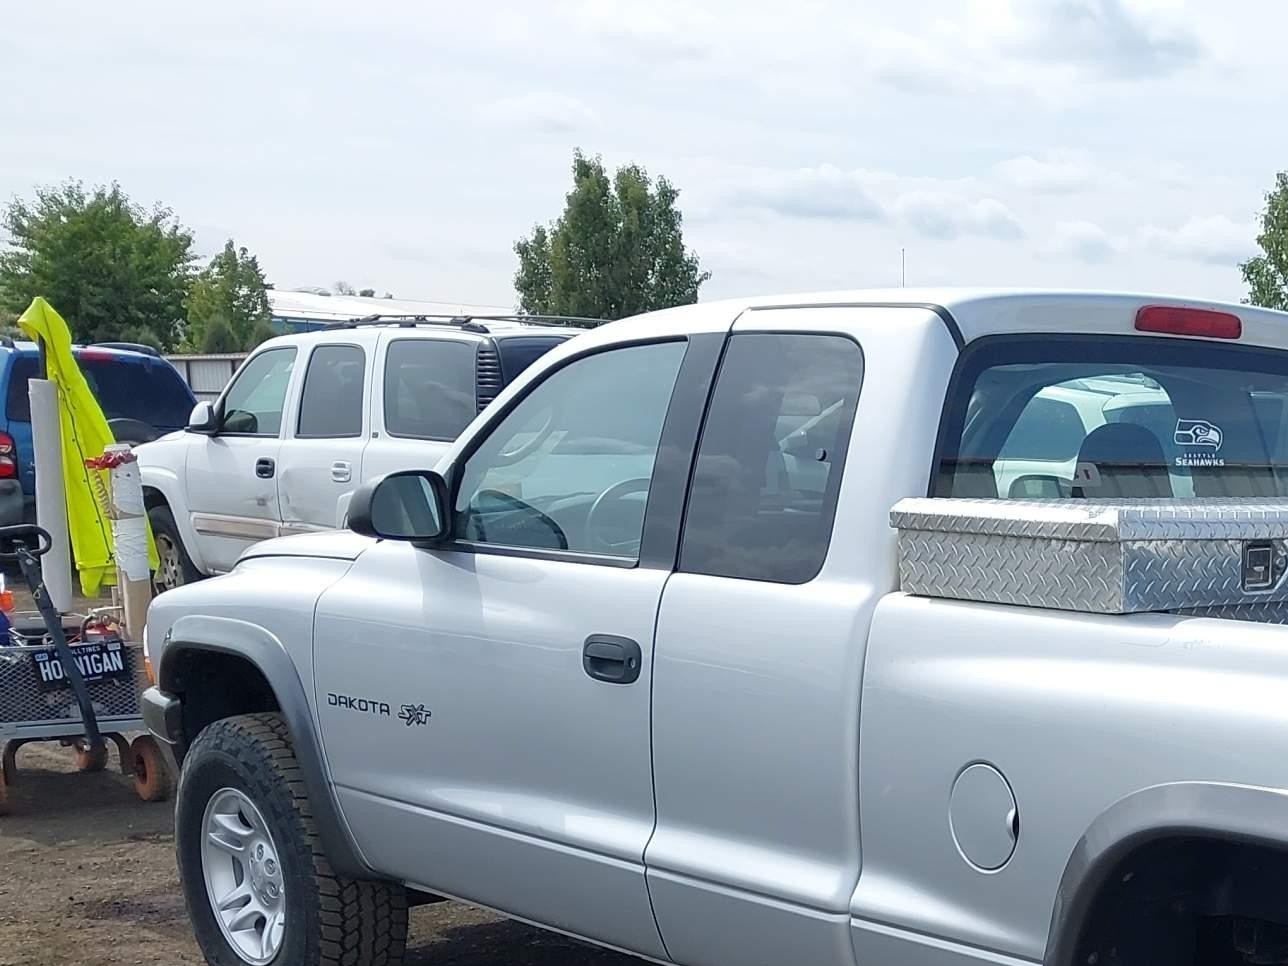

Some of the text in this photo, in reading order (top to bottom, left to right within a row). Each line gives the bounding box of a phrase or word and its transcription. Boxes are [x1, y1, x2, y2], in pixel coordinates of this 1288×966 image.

[1175, 457, 1225, 466] SEAHAWKS
[39, 651, 123, 681] HON1GAN
[327, 693, 431, 726] DAKOTA SXT
